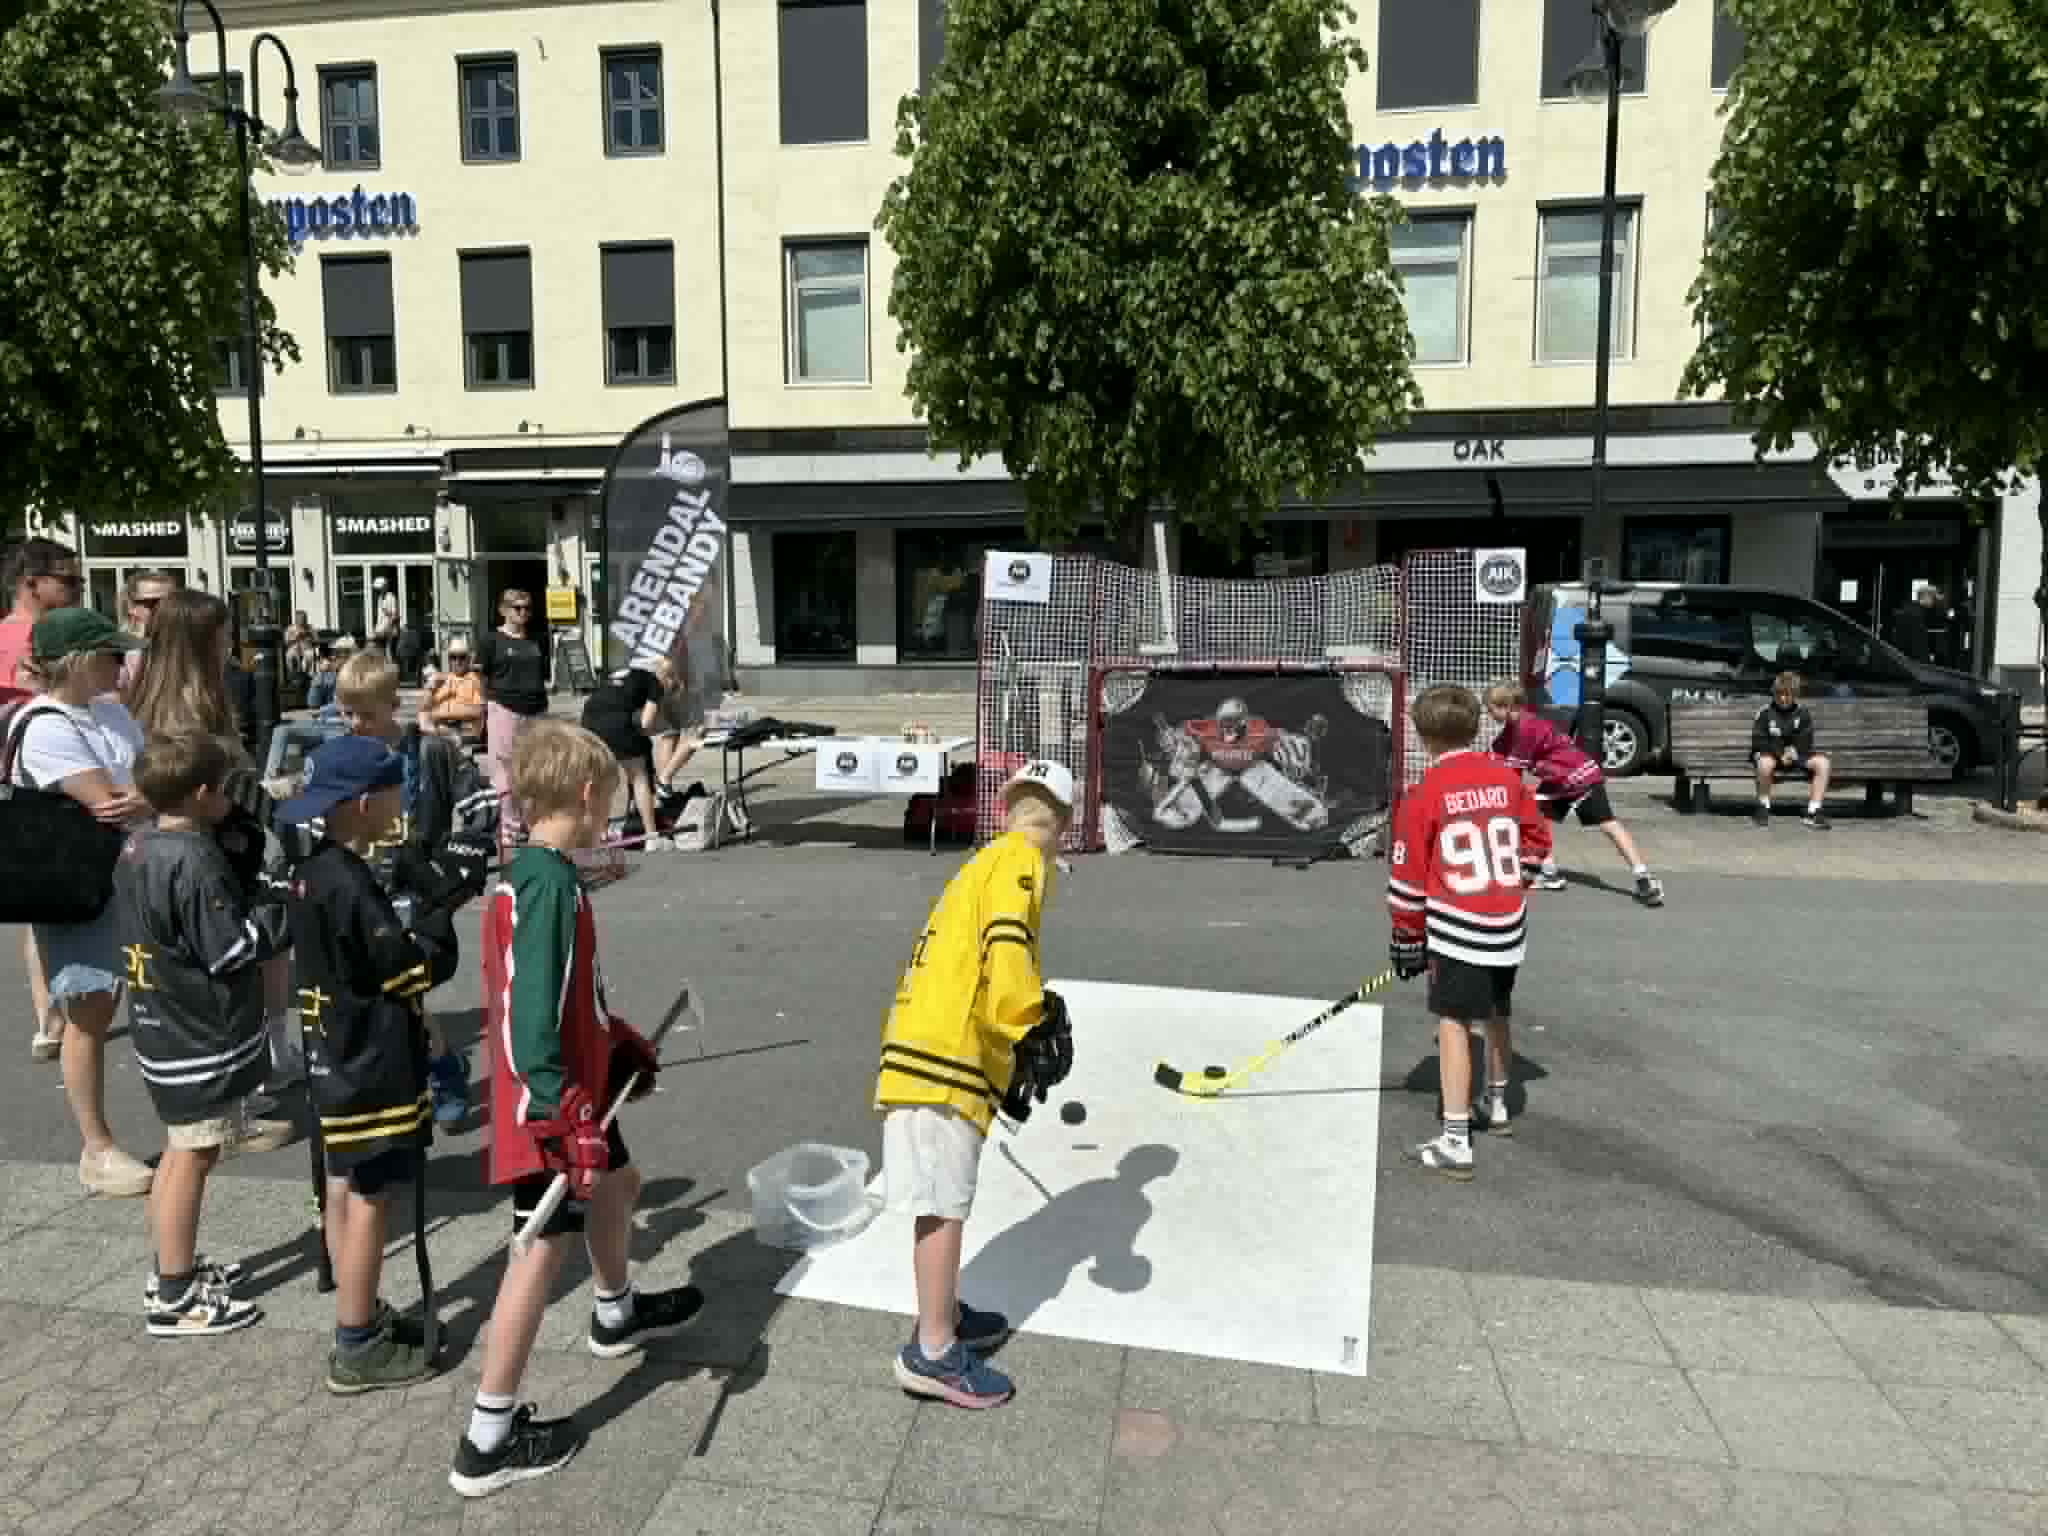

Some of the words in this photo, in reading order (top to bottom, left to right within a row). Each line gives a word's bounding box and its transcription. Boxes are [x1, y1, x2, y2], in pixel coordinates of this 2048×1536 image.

[1454, 439, 1505, 461] OAK
[335, 516, 431, 534] SMASHED
[609, 488, 711, 649] ARENDAL
[1440, 816, 1521, 896] 98
